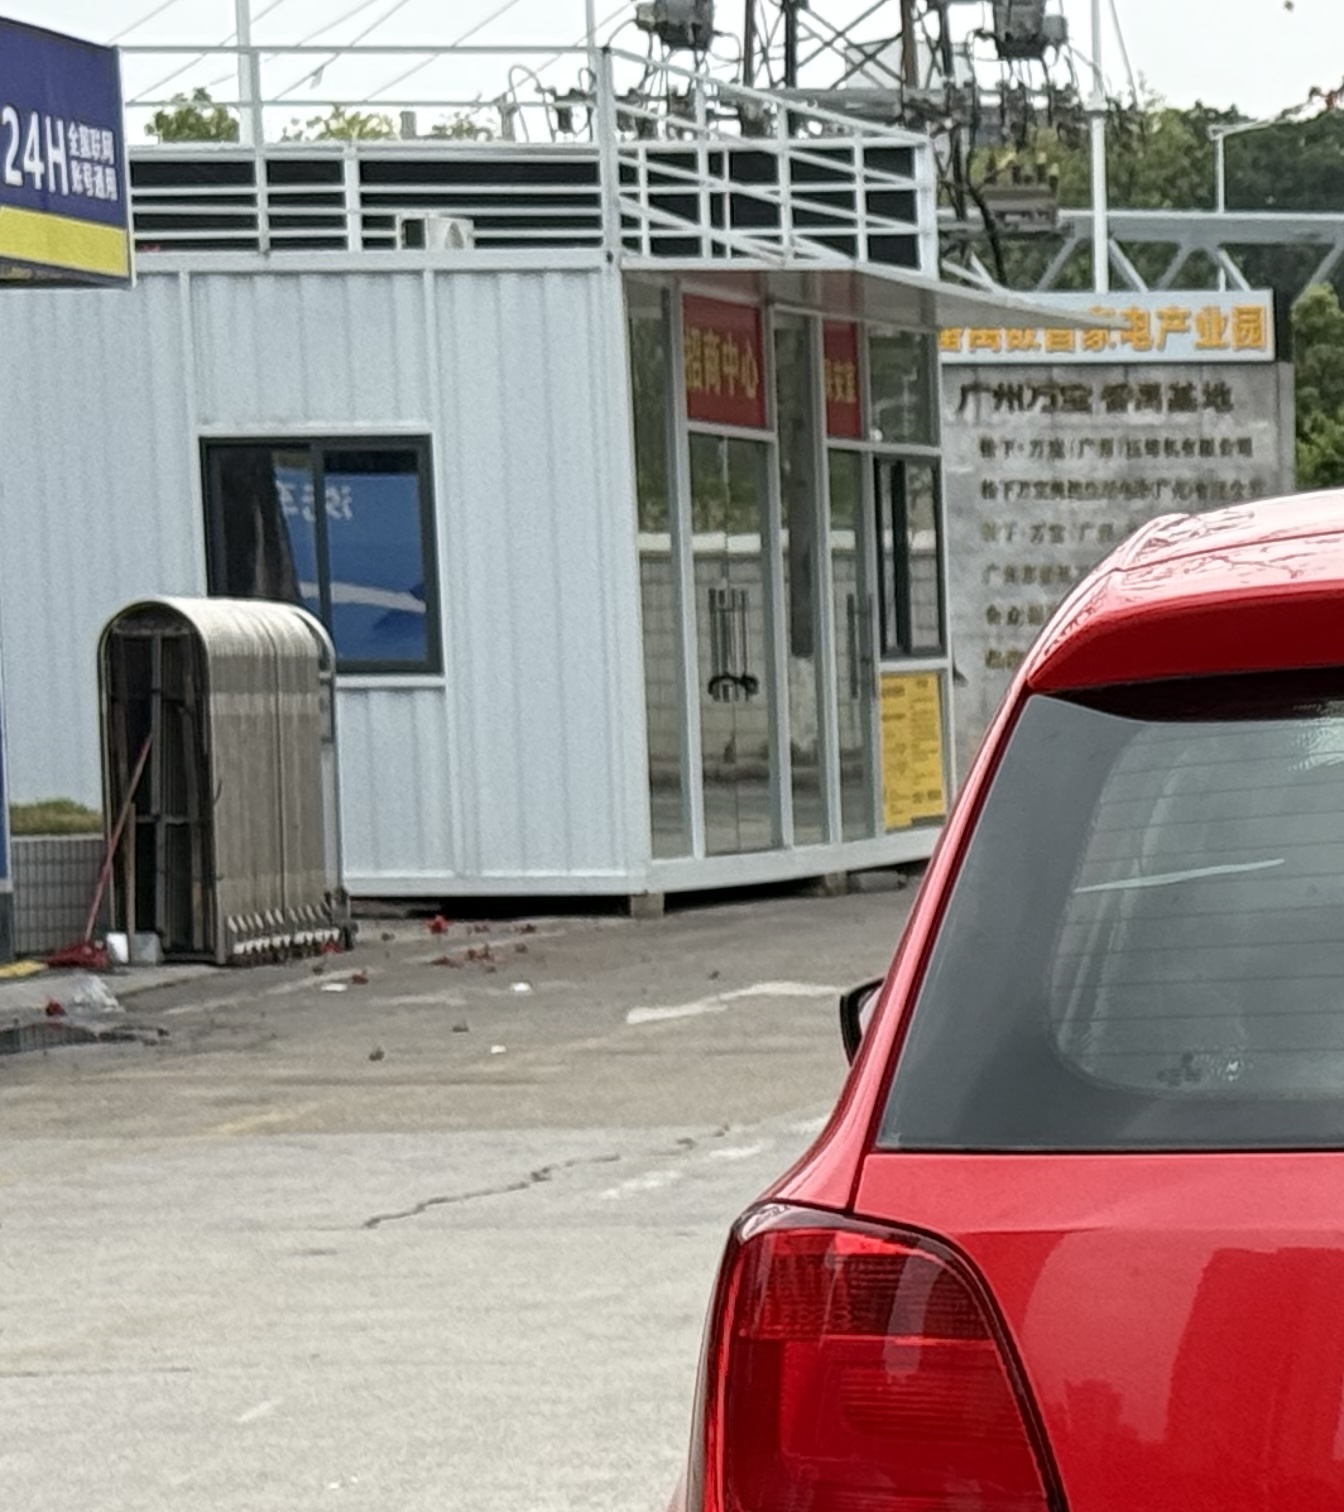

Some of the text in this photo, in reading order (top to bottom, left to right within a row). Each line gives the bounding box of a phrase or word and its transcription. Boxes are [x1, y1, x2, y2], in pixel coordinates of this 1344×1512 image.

[2, 105, 69, 196] 24H
[685, 325, 760, 399] 招商中心
